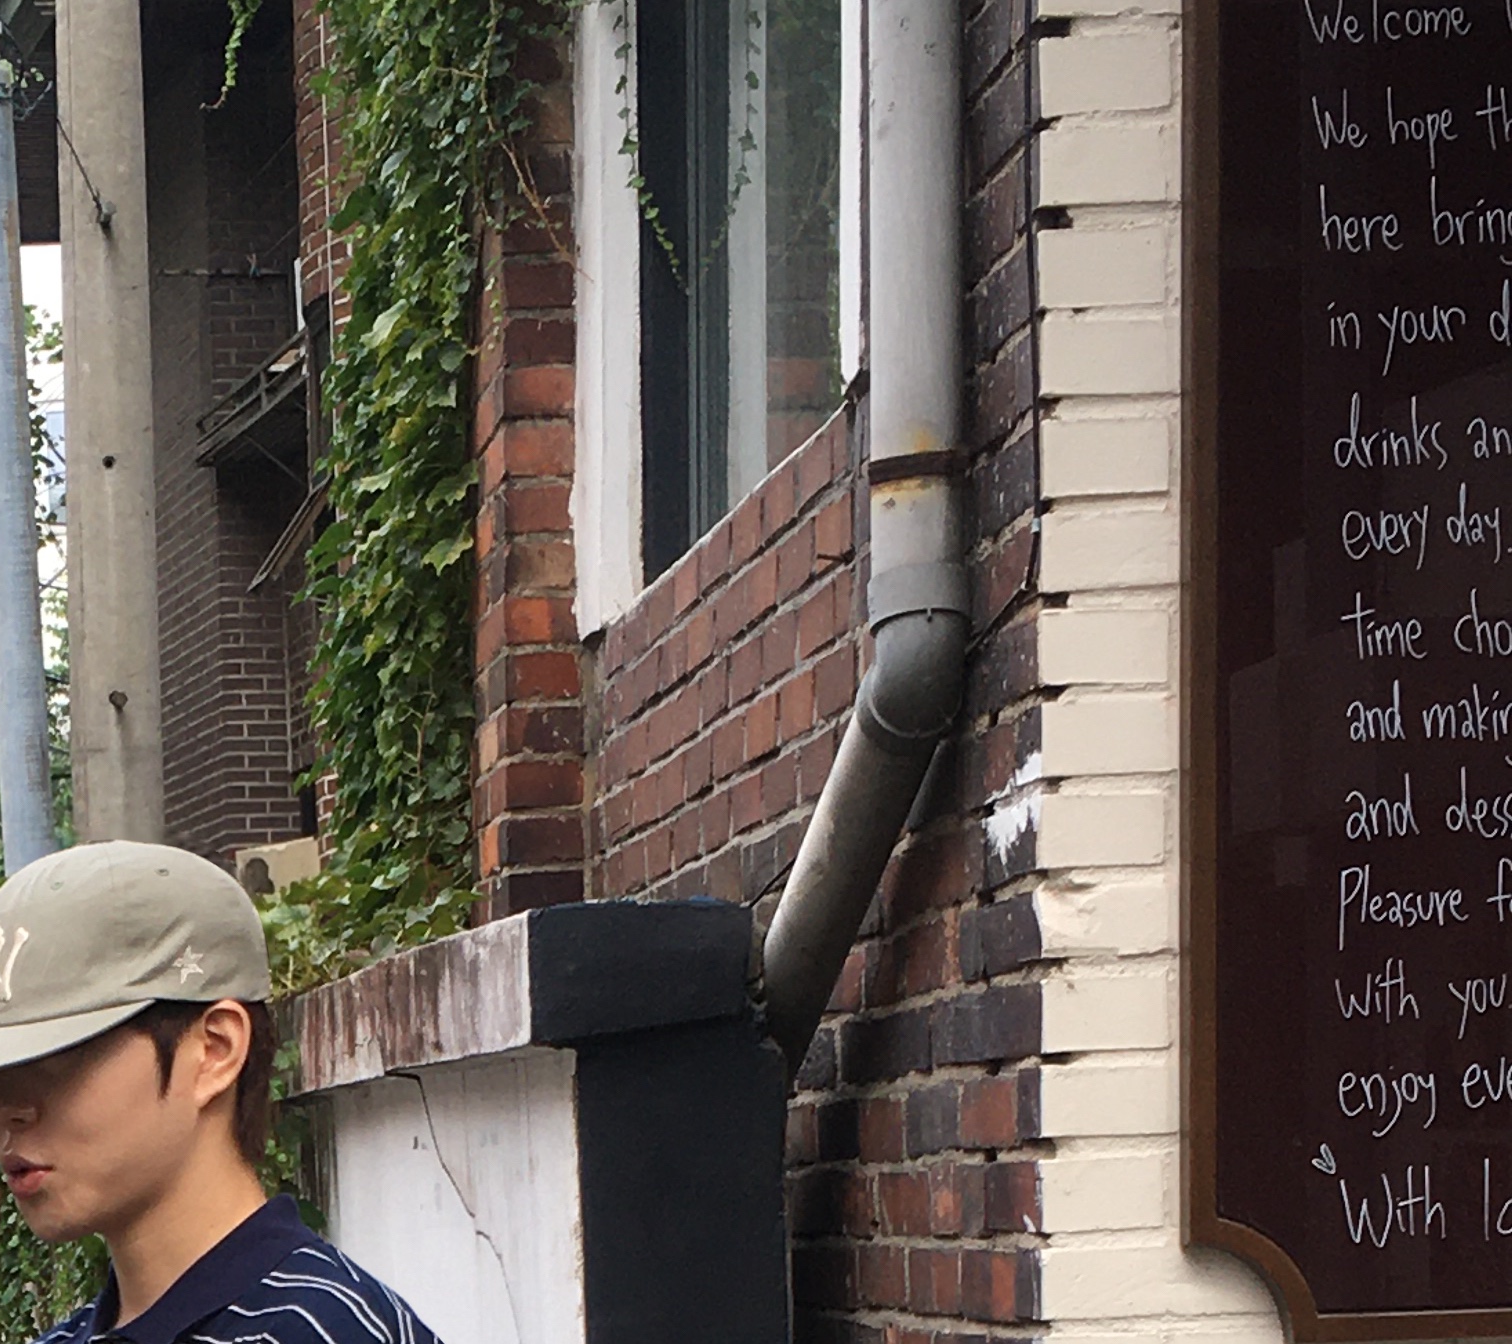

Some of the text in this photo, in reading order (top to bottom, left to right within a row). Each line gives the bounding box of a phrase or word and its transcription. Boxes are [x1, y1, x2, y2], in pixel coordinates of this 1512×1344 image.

[1304, 0, 1471, 43] Welcome
[1311, 89, 1368, 149] We
[1387, 86, 1457, 169] hope
[1319, 175, 1512, 265] here brin
[1327, 301, 1361, 349] in
[1377, 305, 1466, 376] your
[1334, 392, 1448, 471] drinks
[1342, 504, 1429, 570] every
[1340, 591, 1427, 660] time
[1346, 679, 1406, 743] and
[1344, 772, 1420, 841] and
[1339, 857, 1512, 951] Pleasure f
[1334, 957, 1420, 1024] with
[1338, 1065, 1436, 1138] enjoy
[1339, 1165, 1446, 1248] With
